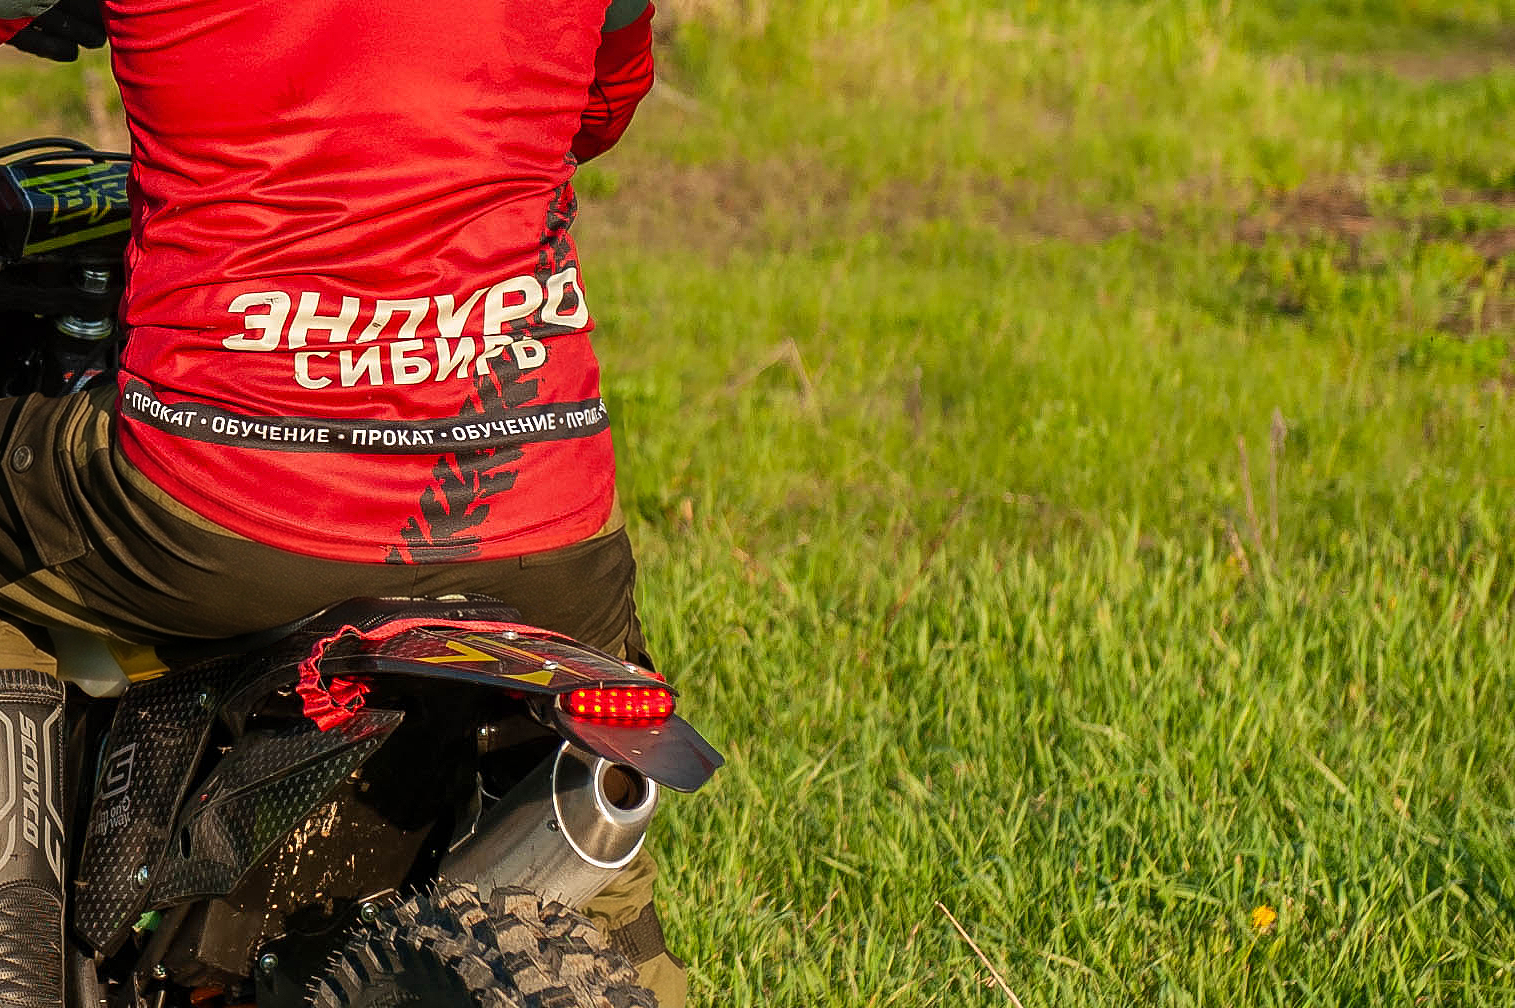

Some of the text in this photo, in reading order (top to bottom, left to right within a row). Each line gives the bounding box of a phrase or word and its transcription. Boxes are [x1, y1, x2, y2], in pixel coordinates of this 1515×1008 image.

[294, 334, 547, 390] СИБИРЬ
[132, 392, 197, 428] ПРОКАТ
[211, 416, 330, 444] ОБУЧЕНИЕ
[351, 429, 434, 446] ПРОКАТ
[451, 412, 557, 442] ОБУЧЕНИЕ
[19, 711, 40, 849] SCOYCO
